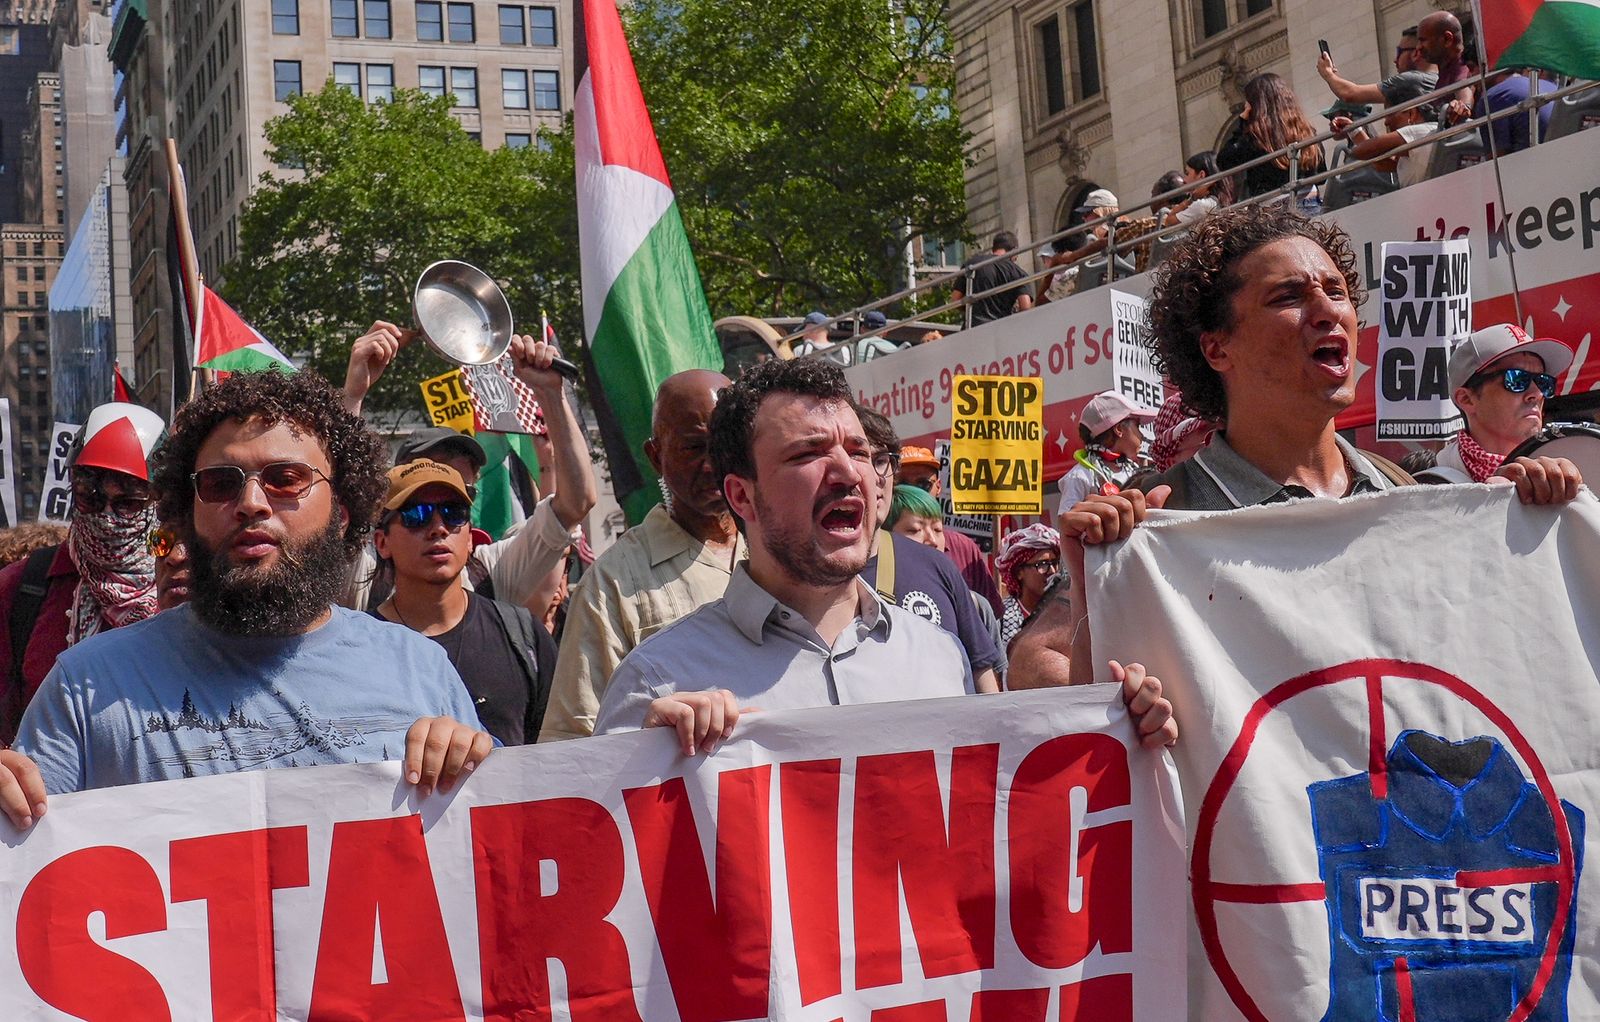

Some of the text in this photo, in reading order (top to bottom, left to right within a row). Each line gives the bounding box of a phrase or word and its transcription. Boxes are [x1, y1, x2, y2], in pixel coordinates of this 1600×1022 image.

[1383, 252, 1468, 299] STAND
[1384, 298, 1468, 338] WITH
[1048, 326, 1076, 374] of
[957, 379, 1037, 417] STOP
[953, 419, 1039, 441] STARVING
[953, 457, 1038, 491] GAZA!
[953, 518, 992, 532] MACHINE
[16, 733, 1133, 1022] STARVING
[1365, 883, 1526, 935] PRESS
